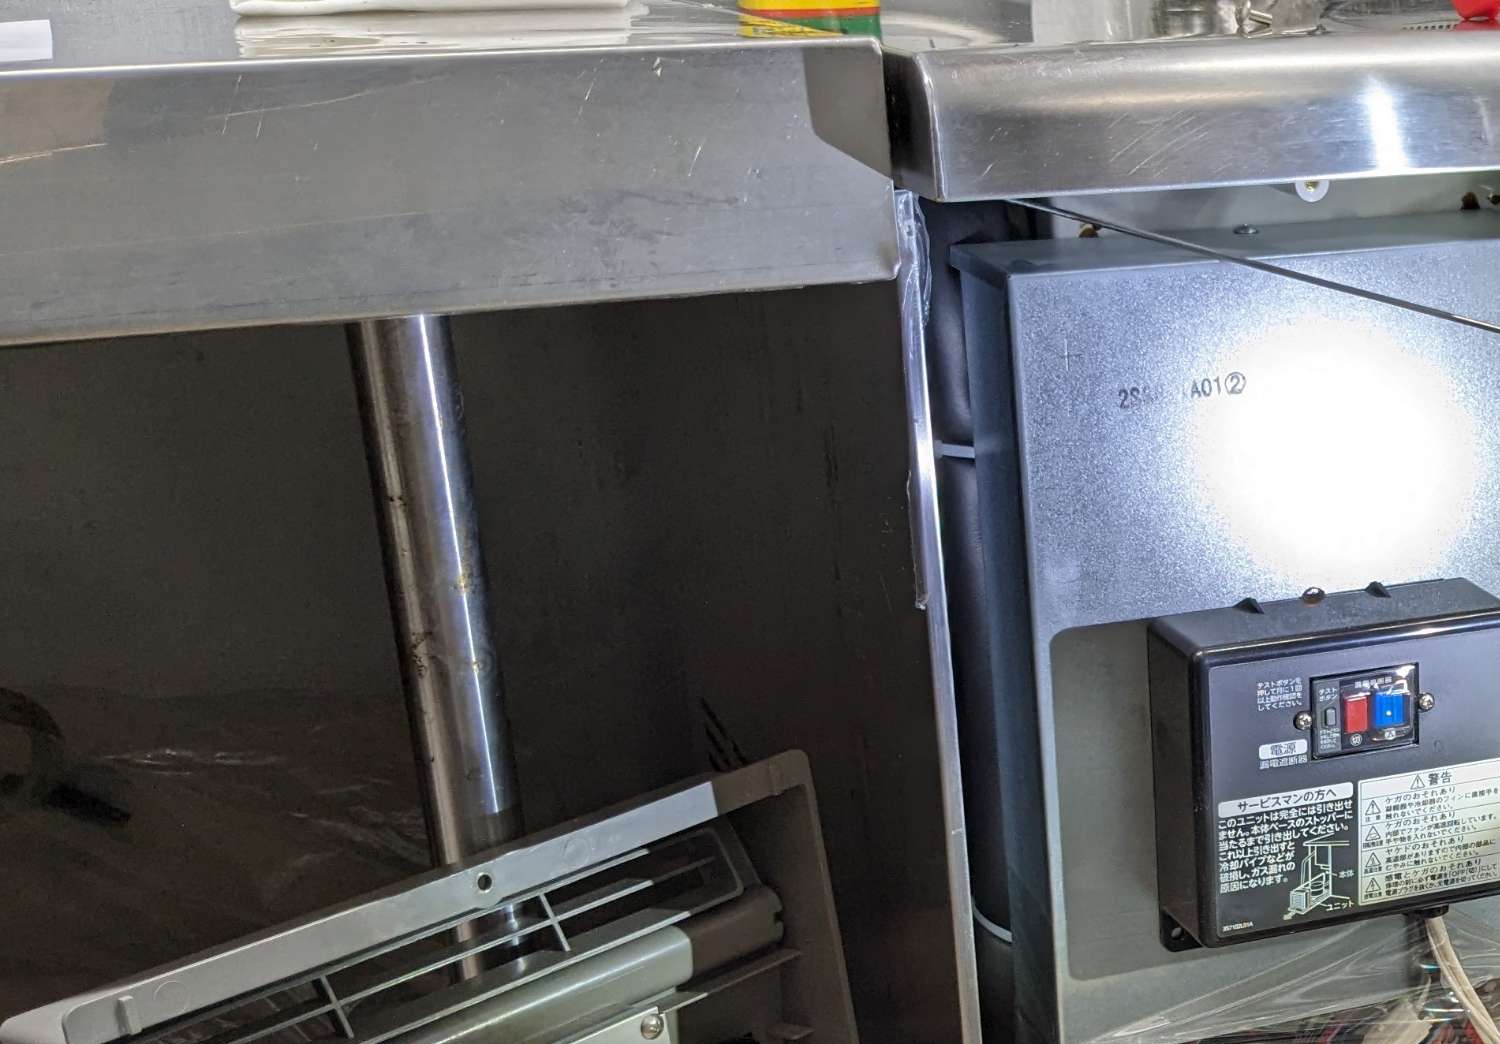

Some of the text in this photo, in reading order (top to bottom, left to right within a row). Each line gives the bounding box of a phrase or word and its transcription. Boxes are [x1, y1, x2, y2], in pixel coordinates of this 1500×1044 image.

[1427, 771, 1452, 785] 警告
[1237, 787, 1336, 812] サービスマンの方へ
[1384, 786, 1455, 804] ケガのおそれあり
[1218, 799, 1352, 829] このユニットは完全には引き出せ
[1385, 811, 1455, 829] ケガのおそれあり
[1218, 821, 1348, 851] 当たるまで引き出してください。
[1385, 835, 1464, 855] ヤケドのおそれあり
[1218, 840, 1295, 861] これ以上引き出すと
[1219, 873, 1288, 893] 原因になります。
[1326, 900, 1354, 911] ユニット
